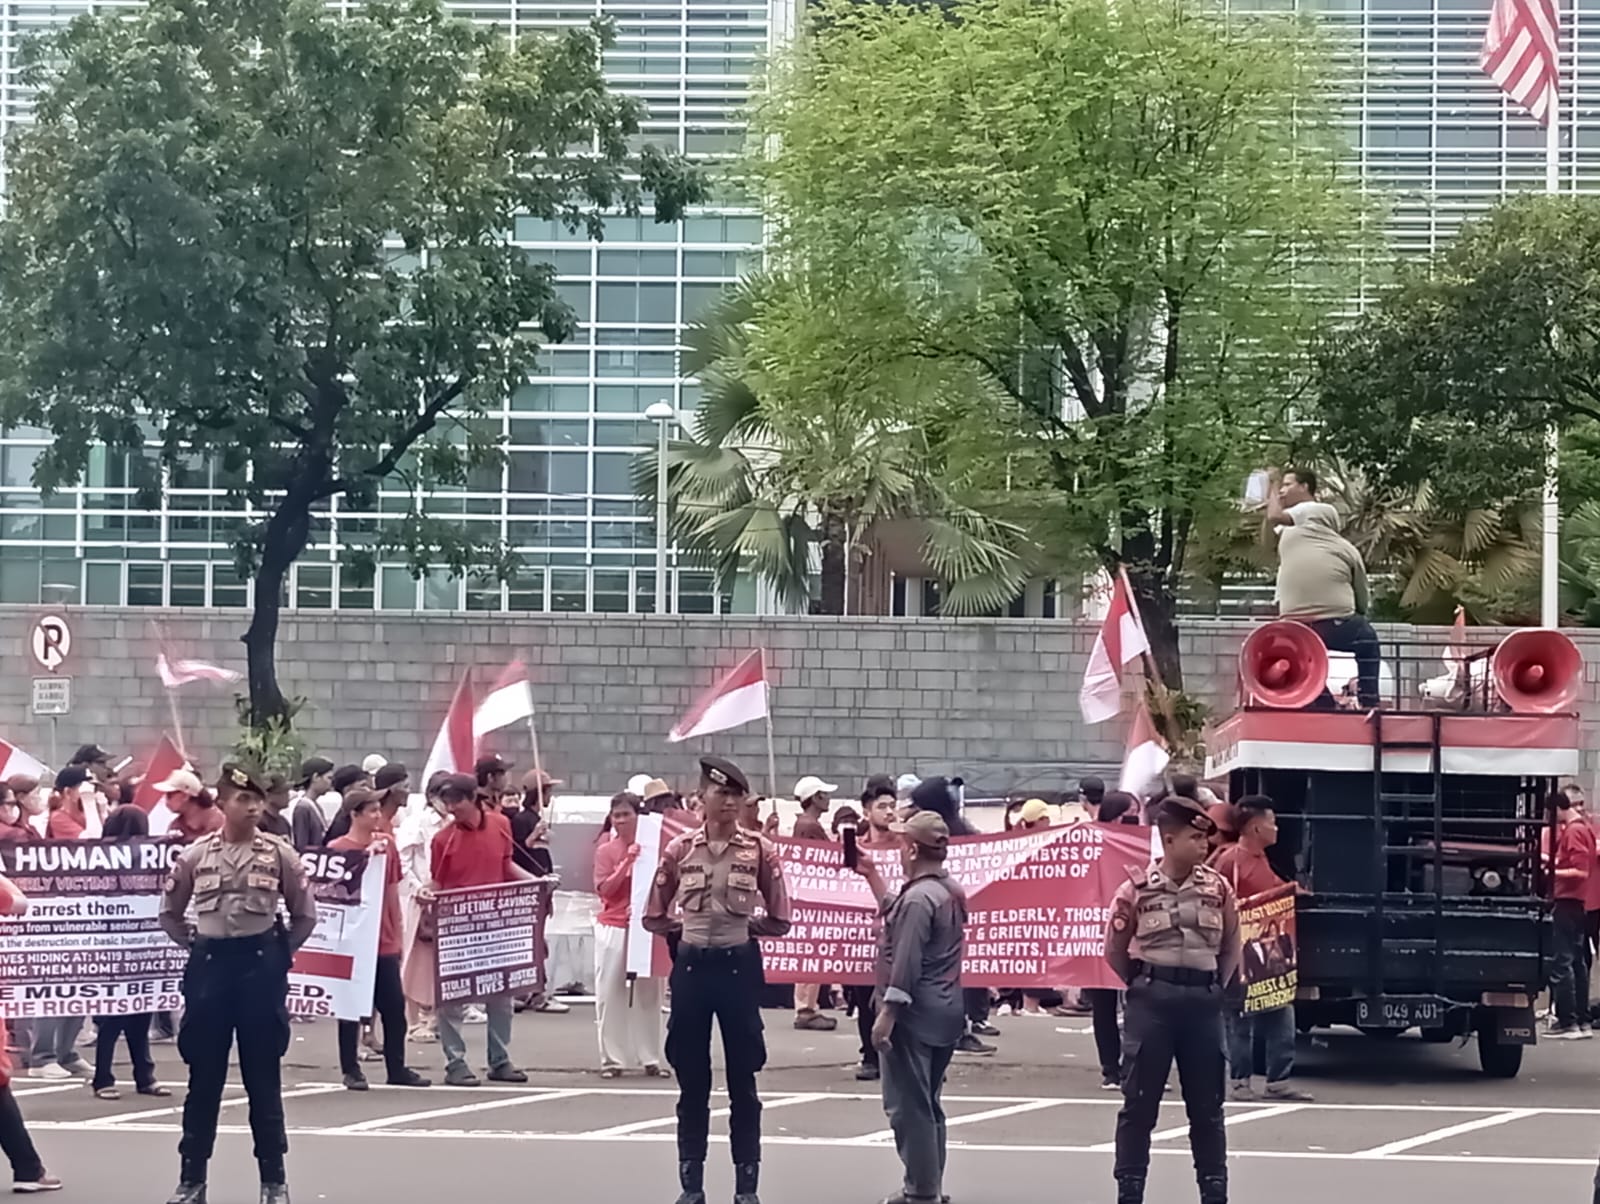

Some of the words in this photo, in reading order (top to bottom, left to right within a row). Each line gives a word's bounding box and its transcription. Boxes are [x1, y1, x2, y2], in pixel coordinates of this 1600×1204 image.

[979, 829, 1104, 855] MANIPULATIONS
[15, 844, 132, 872] HUMAN
[774, 842, 801, 860] Y'S
[965, 856, 1000, 872] INTO
[1030, 847, 1079, 863] ABYSS
[1083, 847, 1104, 861] OF
[984, 864, 1067, 882] VIOLATION
[1070, 864, 1090, 878] OF
[56, 875, 118, 891] VICTIMS
[790, 876, 838, 892] YEARS
[32, 901, 83, 917] arrest
[87, 900, 135, 917] them.
[453, 898, 496, 915] LIFETIME
[991, 907, 1061, 924] ELDERLY,
[1064, 907, 1111, 923] THOSE
[26, 922, 51, 934] from
[52, 920, 108, 933] vulnerable
[110, 920, 139, 932] senior
[438, 926, 449, 936] ALL
[811, 926, 877, 942] MEDICAL
[976, 928, 985, 941] &
[989, 925, 1060, 940] GRIEVING
[7, 938, 22, 948] the
[24, 937, 80, 948] destruction
[82, 936, 92, 946] of
[94, 934, 120, 946] basic
[27, 951, 70, 964] HIDING
[72, 951, 92, 963] AT:
[818, 942, 838, 957] OF
[841, 943, 879, 959] THEI
[968, 943, 1044, 958] BENEFITS,
[1047, 942, 1105, 957] LEAVING
[31, 963, 73, 976] THEM
[77, 962, 121, 975] HOME
[124, 962, 138, 973] TO
[140, 959, 167, 972] FACE
[802, 958, 819, 973] IN
[823, 959, 877, 974] POVER
[25, 984, 121, 999] MUST
[127, 981, 154, 996] BE
[476, 981, 505, 996] LIVES
[43, 999, 129, 1015] RIGHTS
[133, 996, 153, 1012] OF
[1359, 1002, 1369, 1019] B
[1503, 1028, 1531, 1037] TRD
